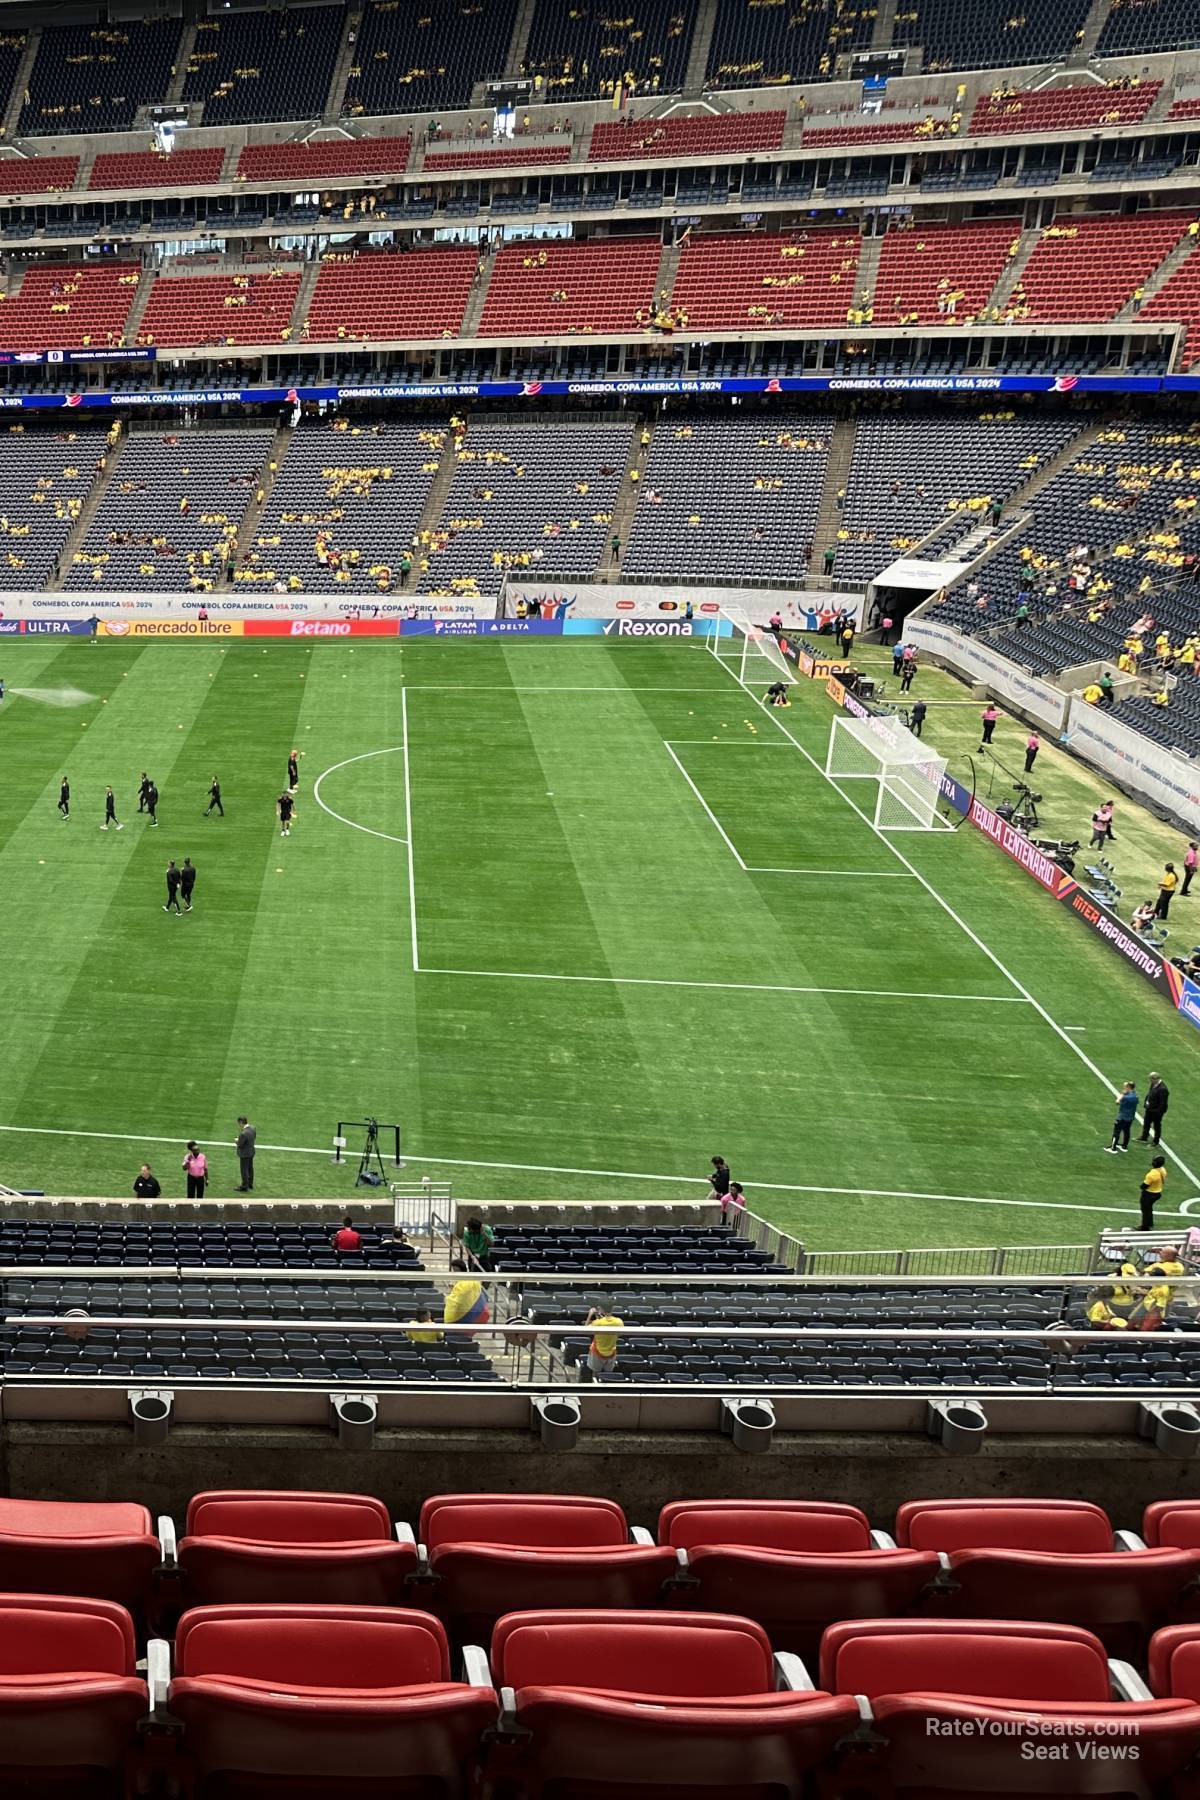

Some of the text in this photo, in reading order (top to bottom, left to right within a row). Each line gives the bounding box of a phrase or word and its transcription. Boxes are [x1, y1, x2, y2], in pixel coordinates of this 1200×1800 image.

[568, 382, 721, 392] CONMEBOL COPA AMERICA USA 2024
[829, 378, 1000, 389] CONMEBOL COPA AMERICA USA 2024
[338, 386, 478, 397] CONMEBOL COPA AMERICA USA 2024
[5, 398, 22, 406] 2024
[111, 396, 151, 404] CONMEBOL
[152, 395, 172, 403] COPA
[172, 394, 206, 402] AMERICA
[28, 622, 70, 632] ULTRA
[135, 621, 231, 633] mercado libre
[290, 621, 350, 635] Betano
[619, 619, 692, 635] Rexona
[972, 800, 1054, 886] TEQUILA CENTENARIO
